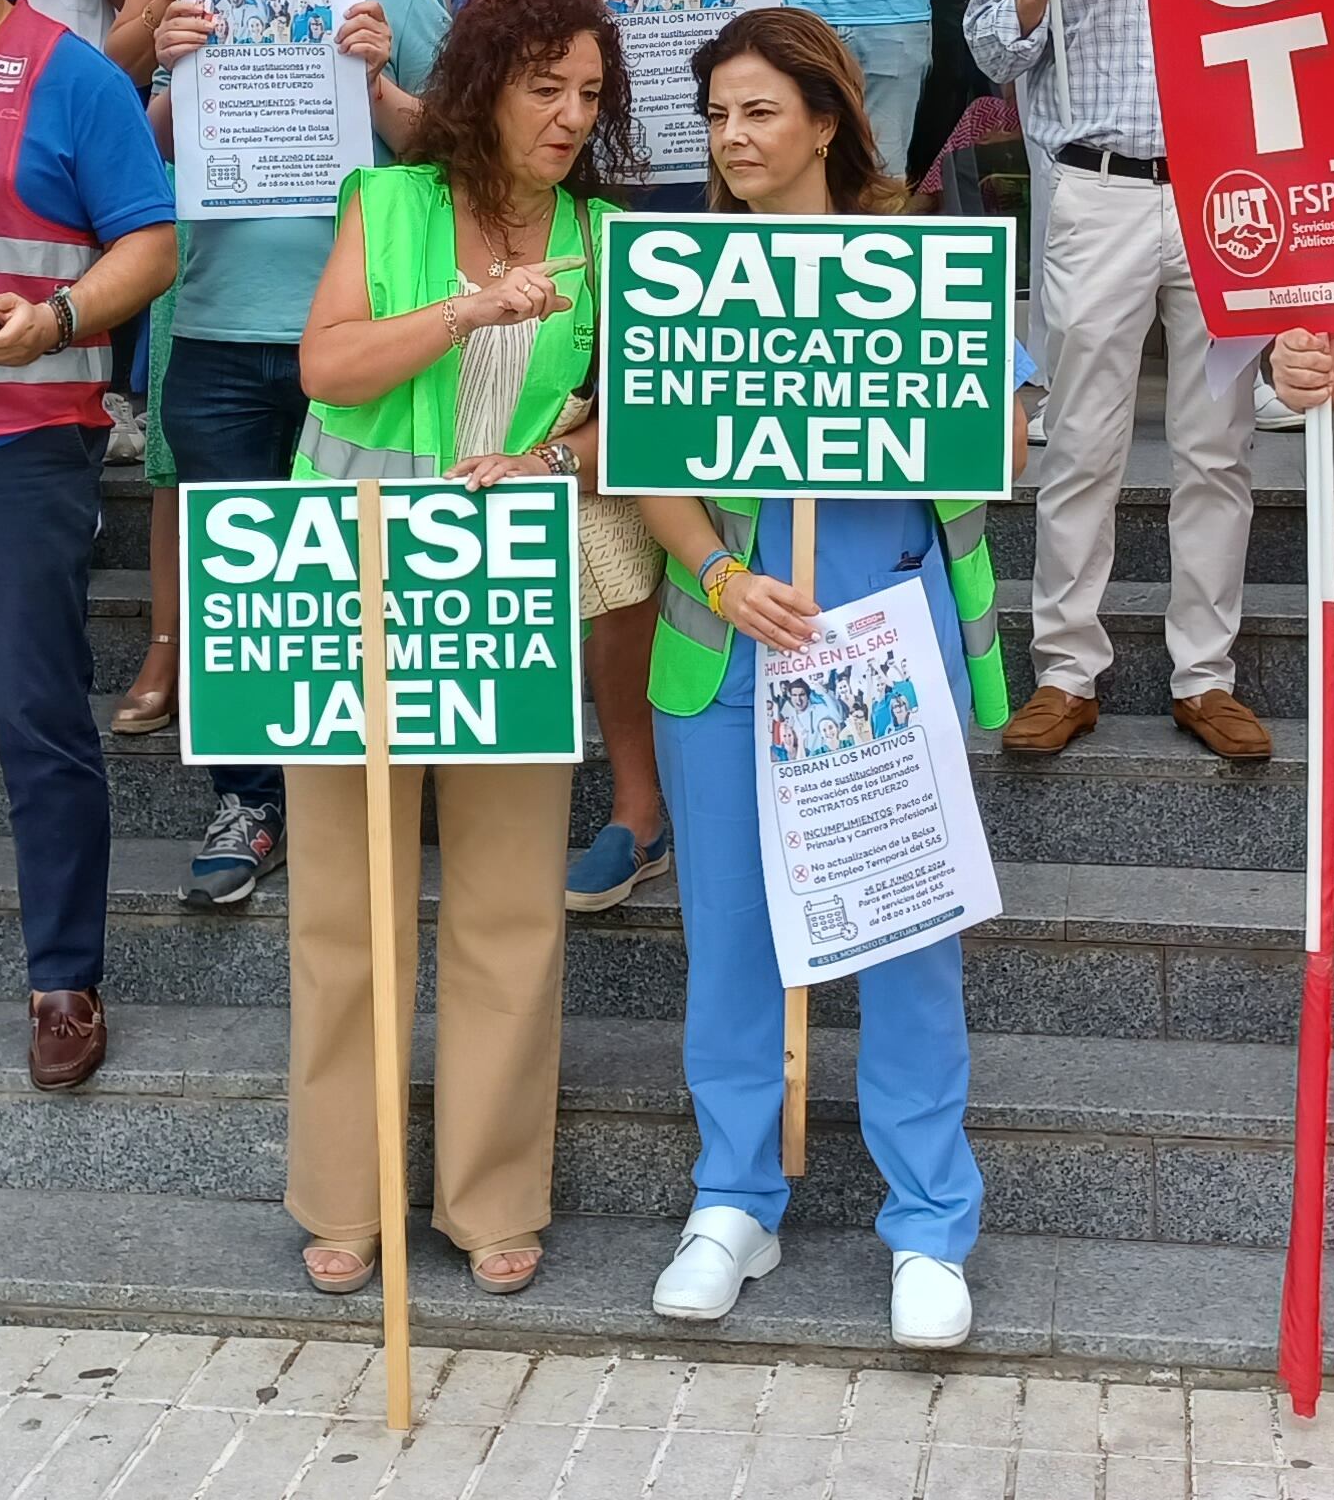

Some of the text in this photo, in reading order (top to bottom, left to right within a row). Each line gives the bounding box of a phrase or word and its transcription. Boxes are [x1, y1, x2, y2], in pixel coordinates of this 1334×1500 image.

[662, 14, 684, 23] LOS
[687, 11, 737, 23] MOTIVOS
[206, 47, 325, 58] SOBRAN LOS MOTIVOS
[1213, 187, 1269, 233] UGT
[623, 231, 996, 321] SATSE
[1269, 285, 1333, 306] Andalucía
[622, 327, 905, 367] SINDICATO
[919, 329, 988, 367] DE
[622, 370, 990, 410] ENFERMERIA
[685, 416, 927, 483] JAEN
[201, 492, 557, 584] SATSE
[487, 588, 555, 626] DE
[820, 648, 842, 666] EN
[847, 643, 866, 659] EL
[866, 628, 899, 652] SAS!
[266, 679, 497, 747] JAEN
[778, 731, 915, 779] SOBRAN LOS MOTIVOS
[794, 781, 818, 794] Falta
[819, 778, 833, 788] de
[903, 754, 914, 763] no
[796, 763, 920, 806] renovación de los llamados
[799, 779, 909, 818] CONTRATOS REFUERZO
